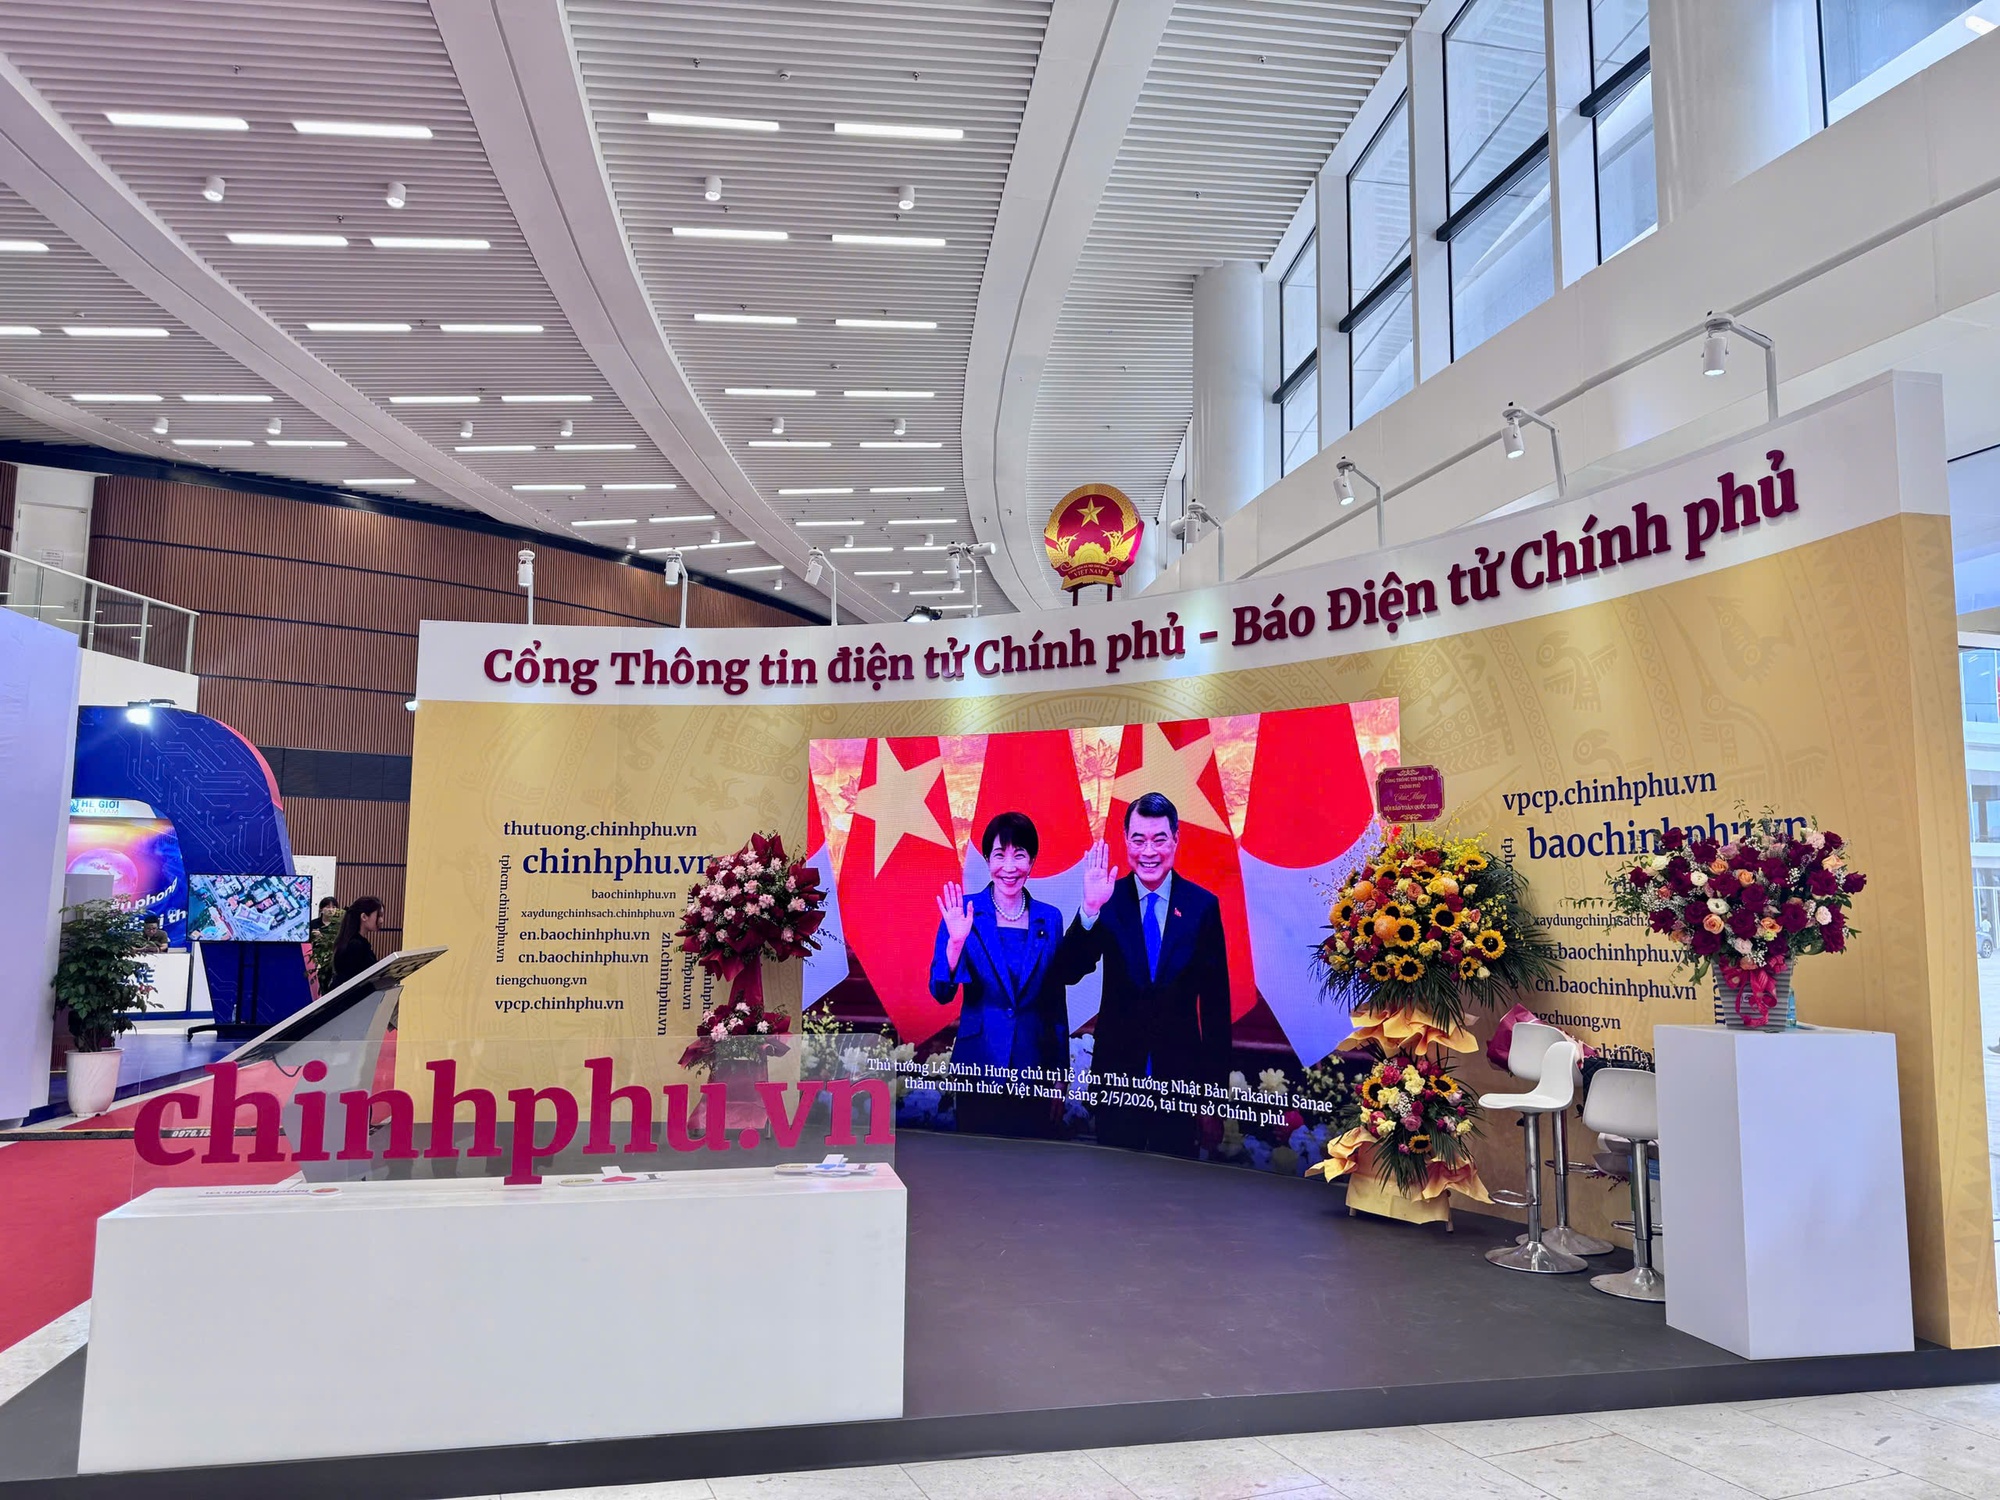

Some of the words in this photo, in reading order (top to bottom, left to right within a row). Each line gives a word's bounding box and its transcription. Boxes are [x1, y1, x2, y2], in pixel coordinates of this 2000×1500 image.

[484, 640, 599, 696] Cổng
[610, 646, 750, 696] Thông
[758, 648, 818, 686] tin
[827, 642, 914, 691] điện
[924, 637, 970, 678] tử
[974, 628, 1096, 675] Chính
[1106, 611, 1186, 674] phủ
[1231, 592, 1316, 646] Báo
[1326, 571, 1438, 634] Điện
[1447, 546, 1506, 606] tử
[1510, 502, 1672, 589] Chính
[1683, 450, 1798, 560] phủ
[1502, 771, 1717, 816] vpcp.chinhphu.vn
[504, 820, 697, 840] thutuong.chinhphu.vn
[496, 854, 512, 962] tphcm.chinhphu.vn
[592, 889, 676, 901] baochinhphu.vn
[521, 908, 675, 920] xaydungchinhsach.chinhphu.vn
[519, 928, 650, 943] en.baochinhphu.vn
[518, 951, 649, 966] cn.baochinhphu.vn
[496, 974, 587, 988] tiengchuong.vn
[656, 932, 673, 1036] zh.chinhphu.vn
[1536, 976, 1697, 1002] cn.baochinhphu.vn
[495, 996, 624, 1013] vpcp.chinhphu.vn
[867, 1058, 890, 1072] Thủ
[894, 1058, 929, 1076] tướng
[932, 1060, 946, 1074] Lê
[949, 1062, 981, 1077] Minh
[984, 1065, 1018, 1082] Hưng
[1021, 1065, 1043, 1080] chủ
[1064, 1067, 1075, 1082] lễ
[1077, 1069, 1100, 1085] đón
[1104, 1072, 1129, 1087] Thủ
[1132, 1075, 1169, 1095] tướng
[1171, 1079, 1201, 1097] Nhật
[1204, 1083, 1228, 1099] Bản
[1232, 1087, 1289, 1108] Takaichi
[1292, 1094, 1333, 1113] Sanae
[904, 1076, 936, 1090] thăm
[939, 1078, 973, 1093] chính
[976, 1080, 1003, 1095] thức
[1006, 1082, 1030, 1100] Việt
[1033, 1085, 1066, 1102] Nam,
[1068, 1087, 1098, 1105] sáng
[1100, 1090, 1157, 1112] 2/5/2026,
[1160, 1099, 1176, 1116] tại
[1178, 1101, 1198, 1119] trụ
[1200, 1103, 1215, 1116] sở
[1217, 1104, 1257, 1122] Chính
[1260, 1110, 1289, 1127] phủ.
[133, 1056, 896, 1186] chinhphu.vn
